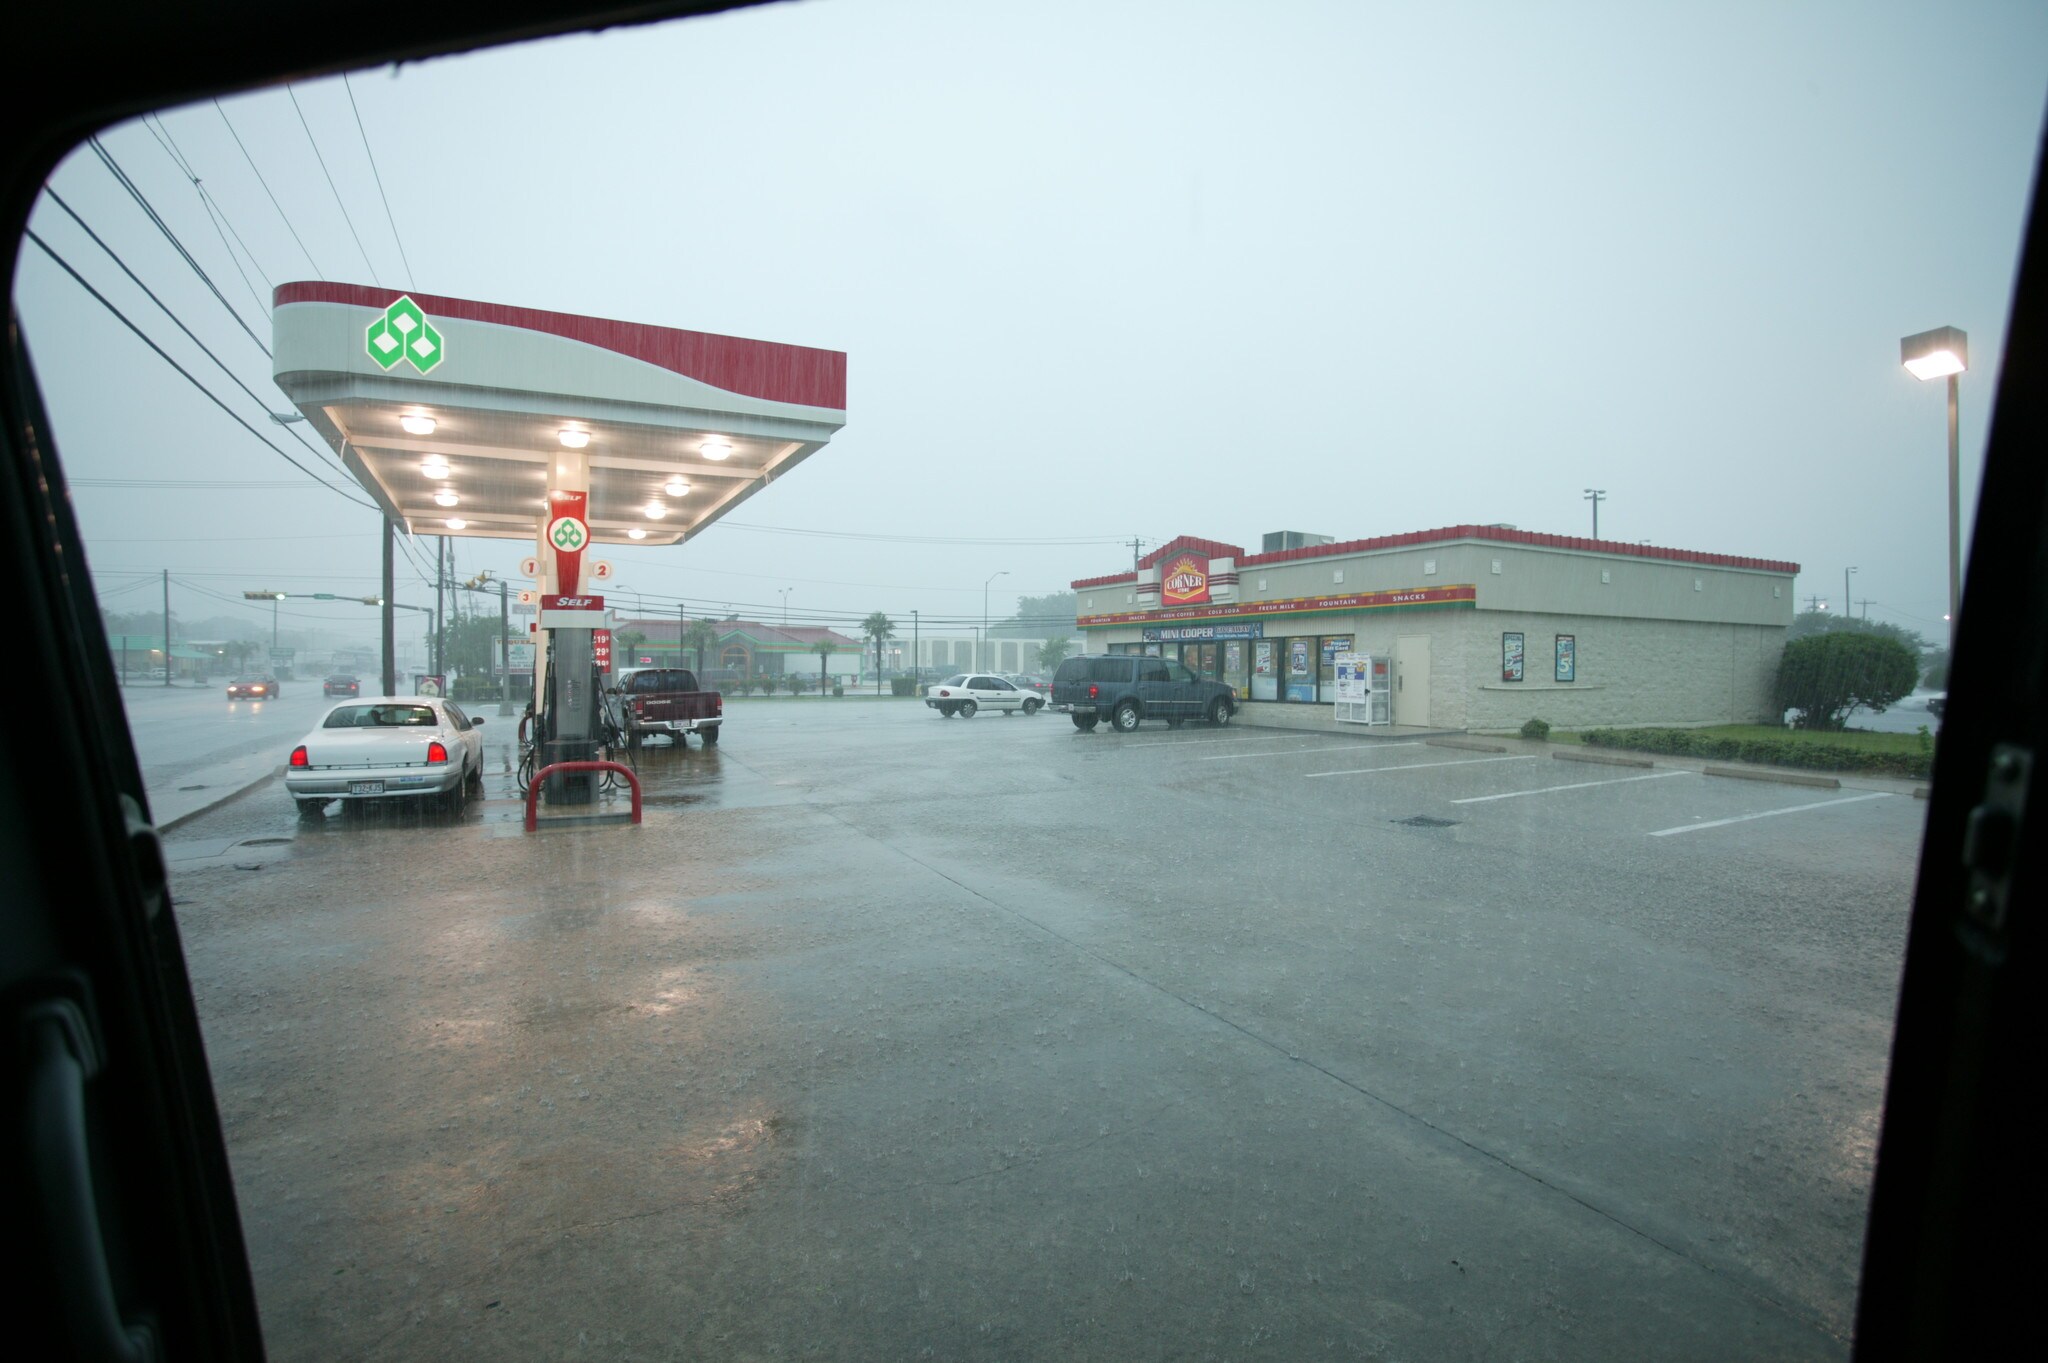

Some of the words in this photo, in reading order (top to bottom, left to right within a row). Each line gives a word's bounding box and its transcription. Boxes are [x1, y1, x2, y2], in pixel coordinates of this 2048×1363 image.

[529, 562, 534, 573] 1
[598, 565, 606, 575] 2
[1167, 574, 1202, 590] CORNER
[523, 593, 529, 601] 3
[557, 597, 592, 606] SELF
[1392, 593, 1426, 602] SNACKS
[1319, 599, 1357, 607] FOUNTAIN
[1160, 629, 1179, 639] MINI
[1180, 627, 1214, 638] COOPER
